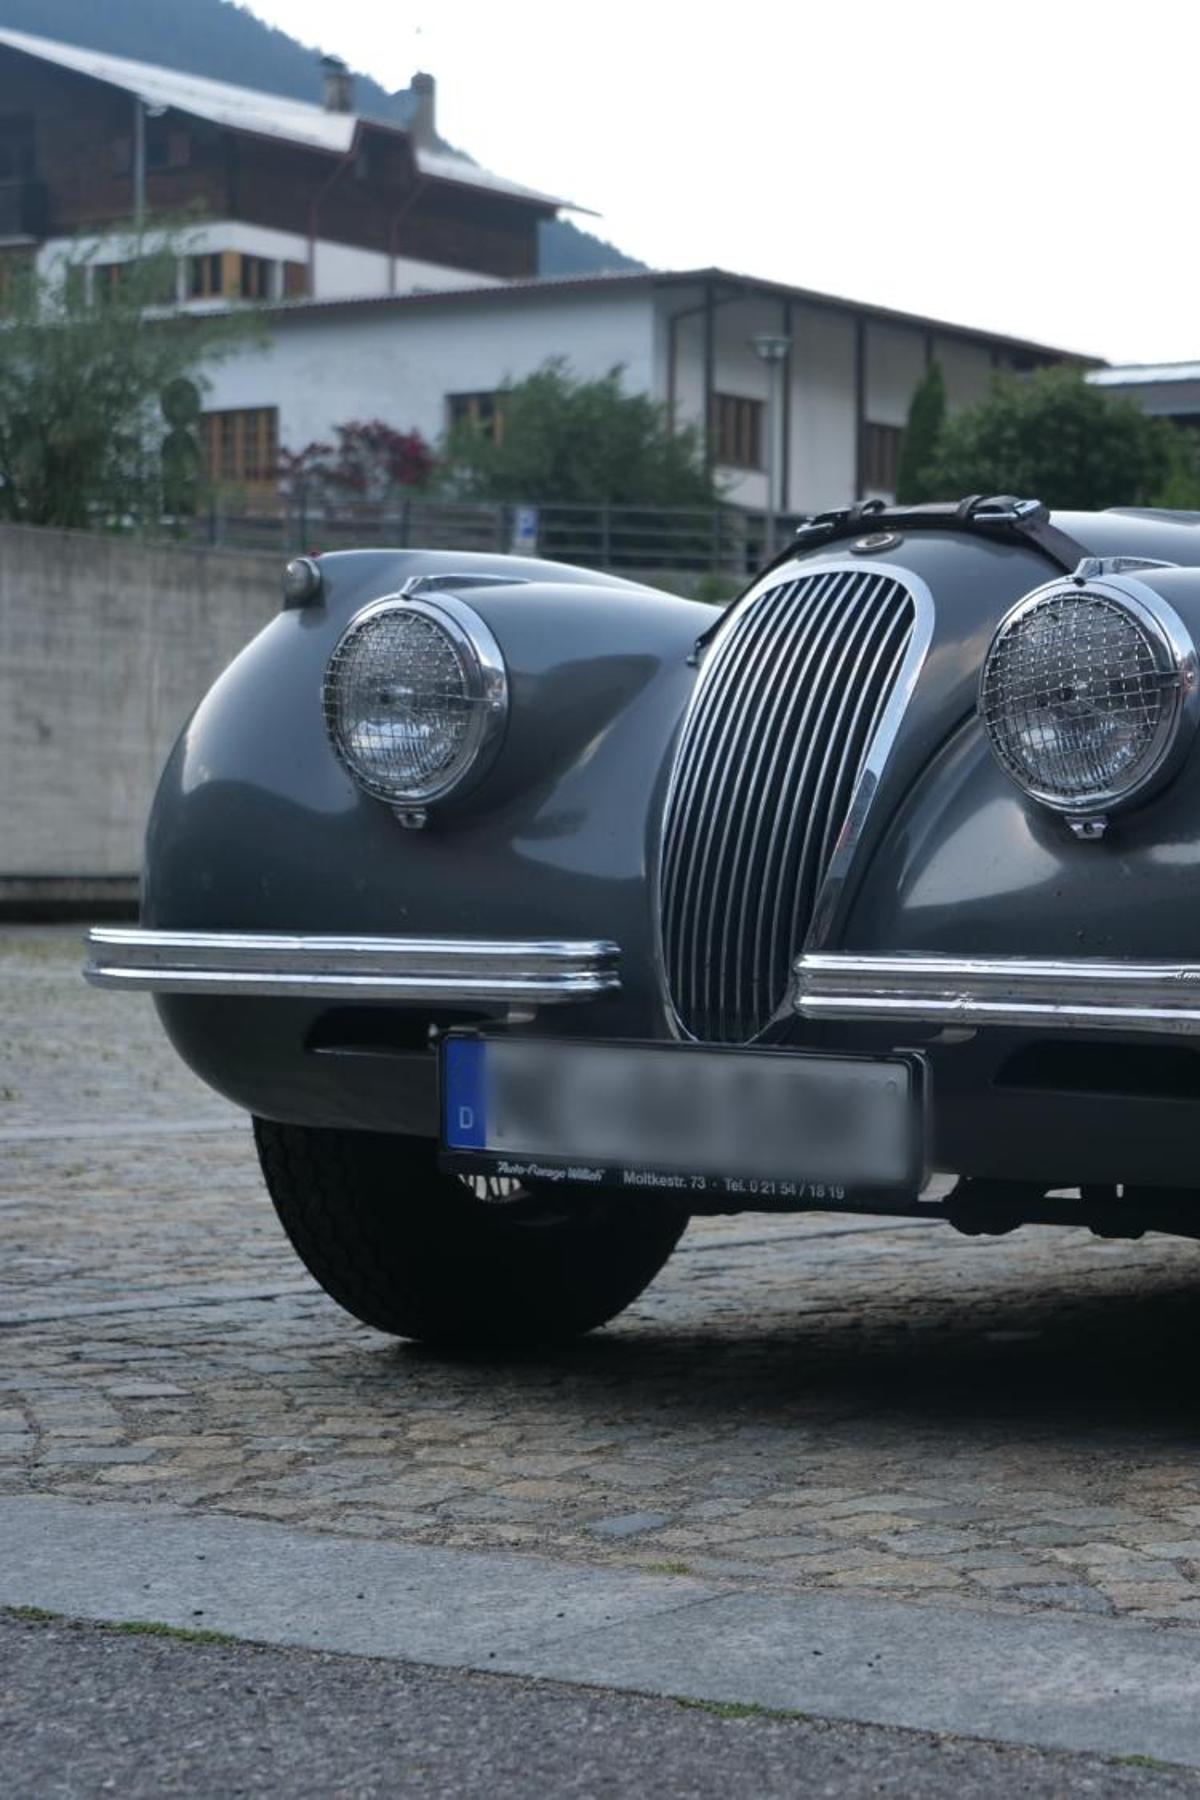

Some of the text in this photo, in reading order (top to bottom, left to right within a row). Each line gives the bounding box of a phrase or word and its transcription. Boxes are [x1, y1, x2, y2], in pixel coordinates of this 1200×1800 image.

[459, 1106, 474, 1129] D
[624, 1170, 688, 1188] Moltkestr.
[691, 1176, 706, 1190] 73
[724, 1177, 746, 1192] Tel.
